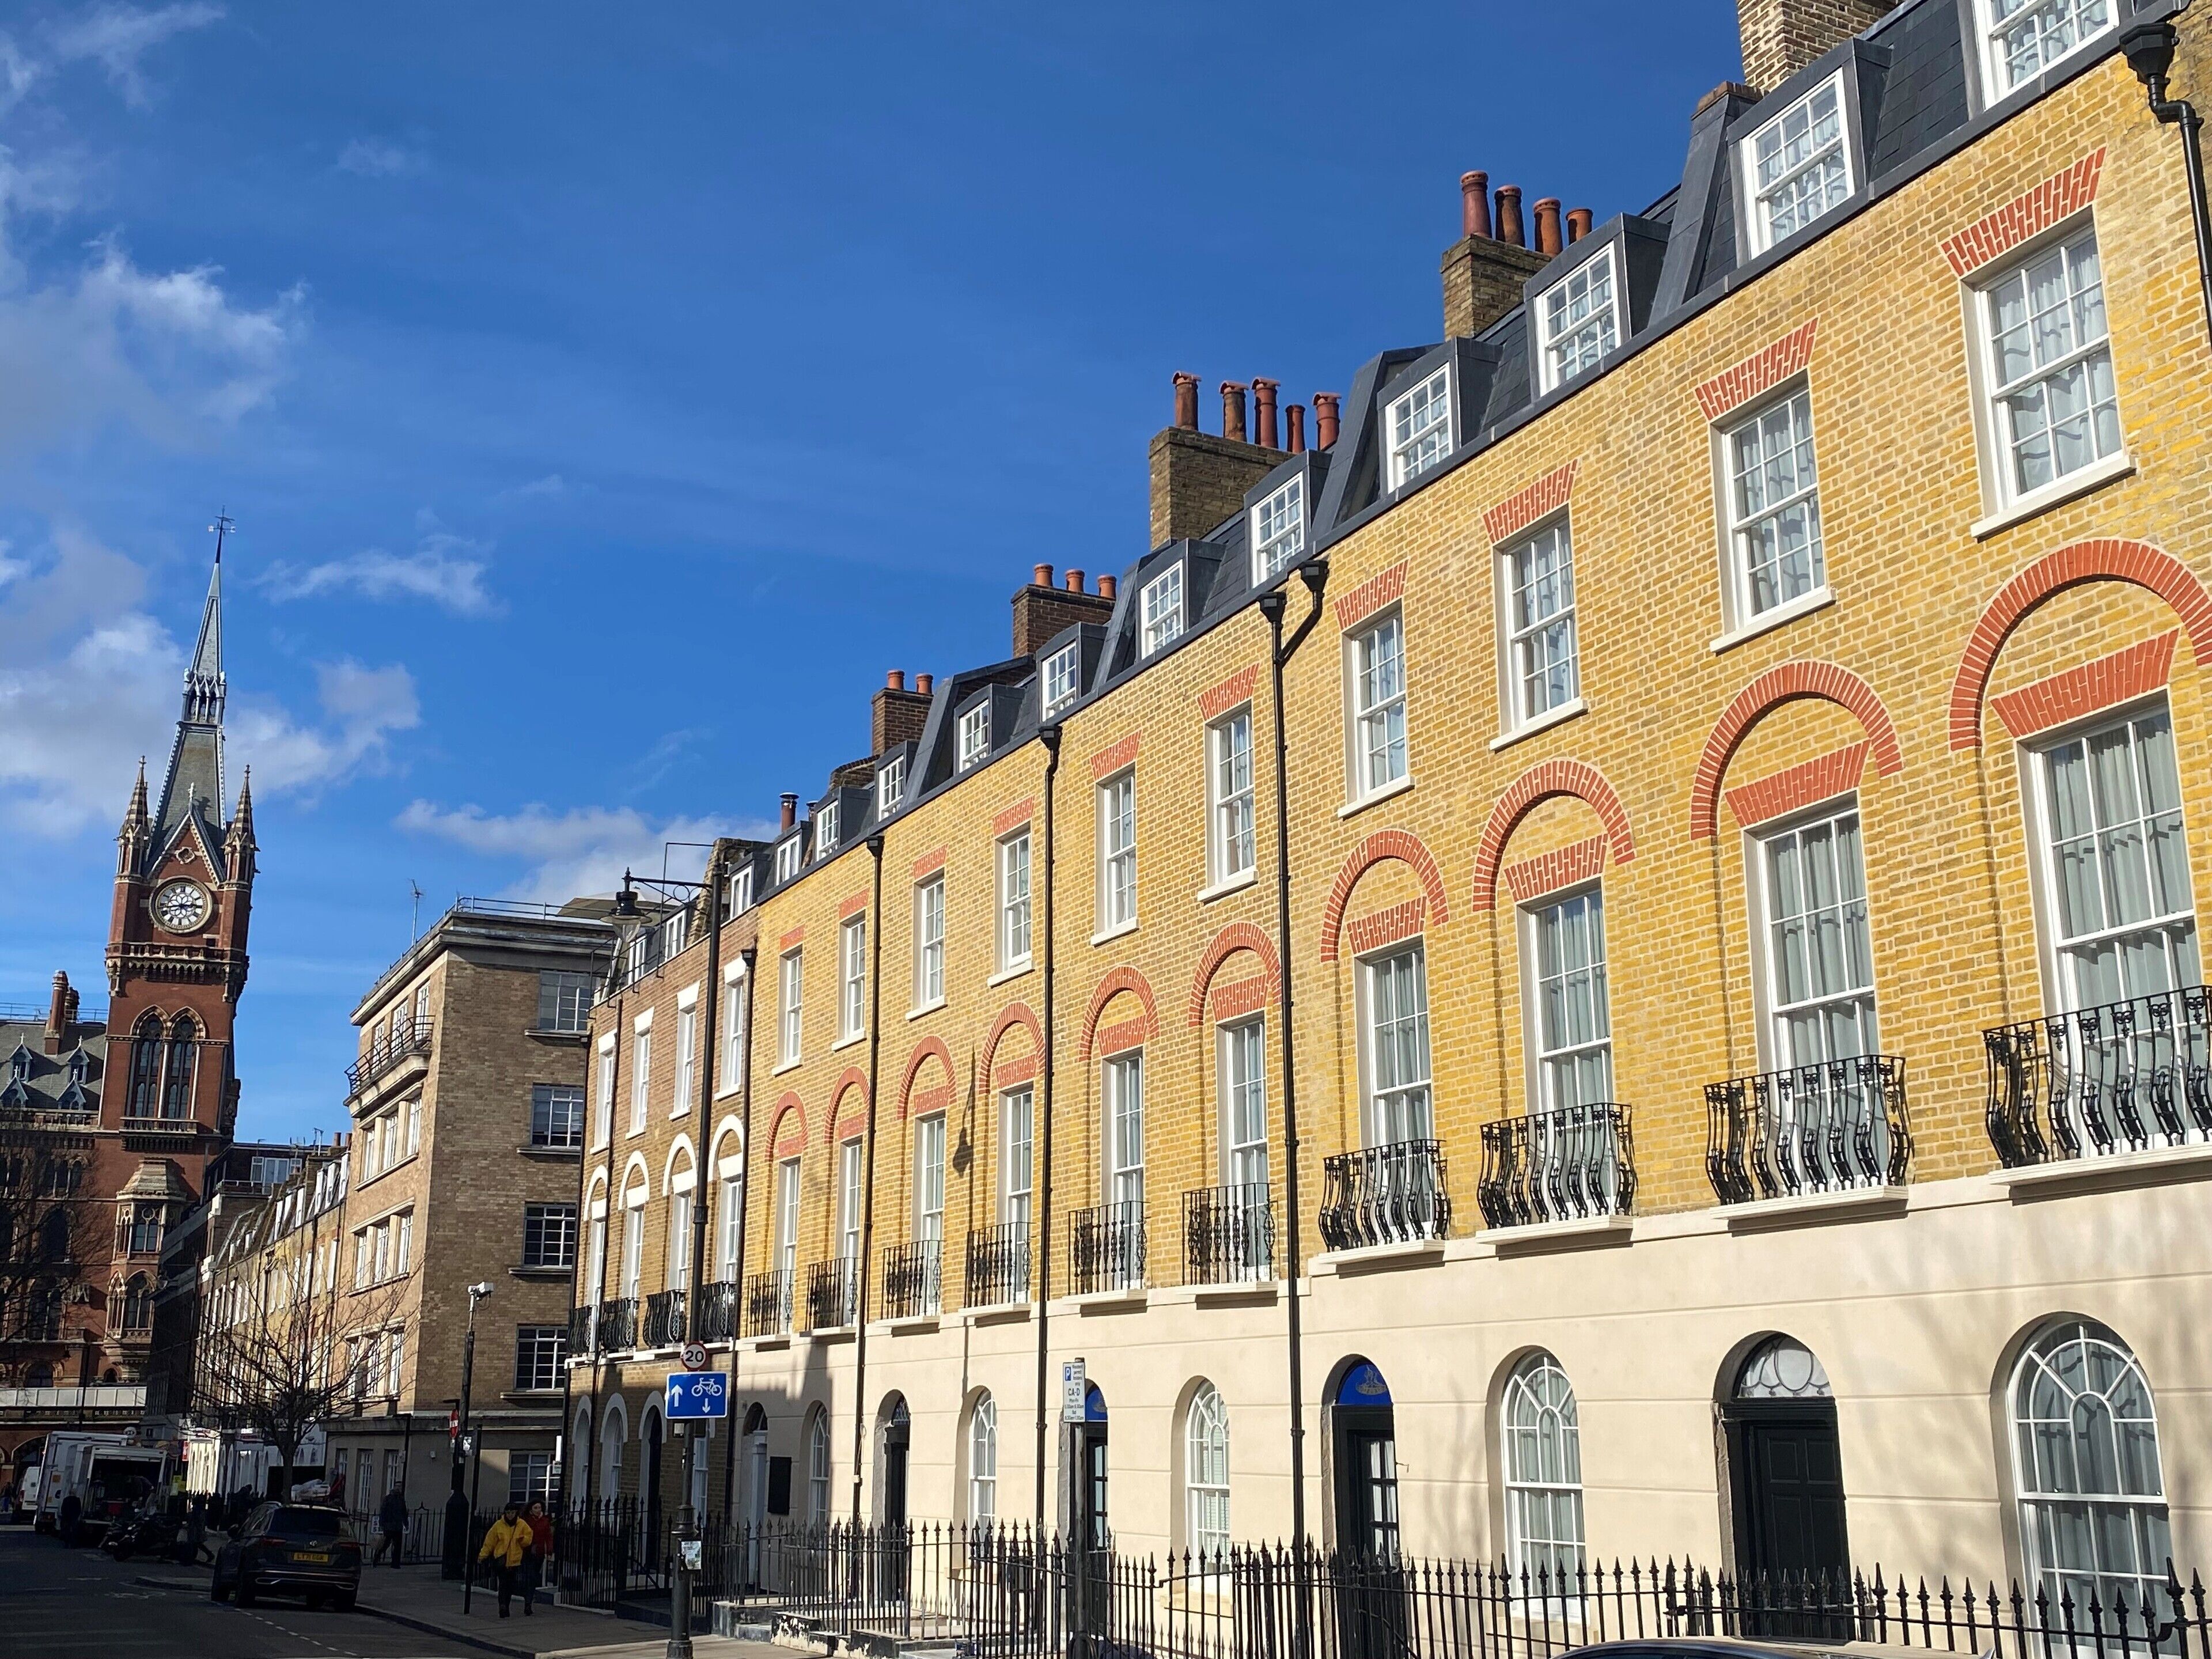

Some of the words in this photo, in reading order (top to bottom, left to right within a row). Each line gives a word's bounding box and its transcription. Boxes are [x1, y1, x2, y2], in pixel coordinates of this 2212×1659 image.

[685, 1350, 704, 1362] 20
[1066, 1367, 1070, 1381] P
[1068, 1388, 1080, 1396] CA-D
